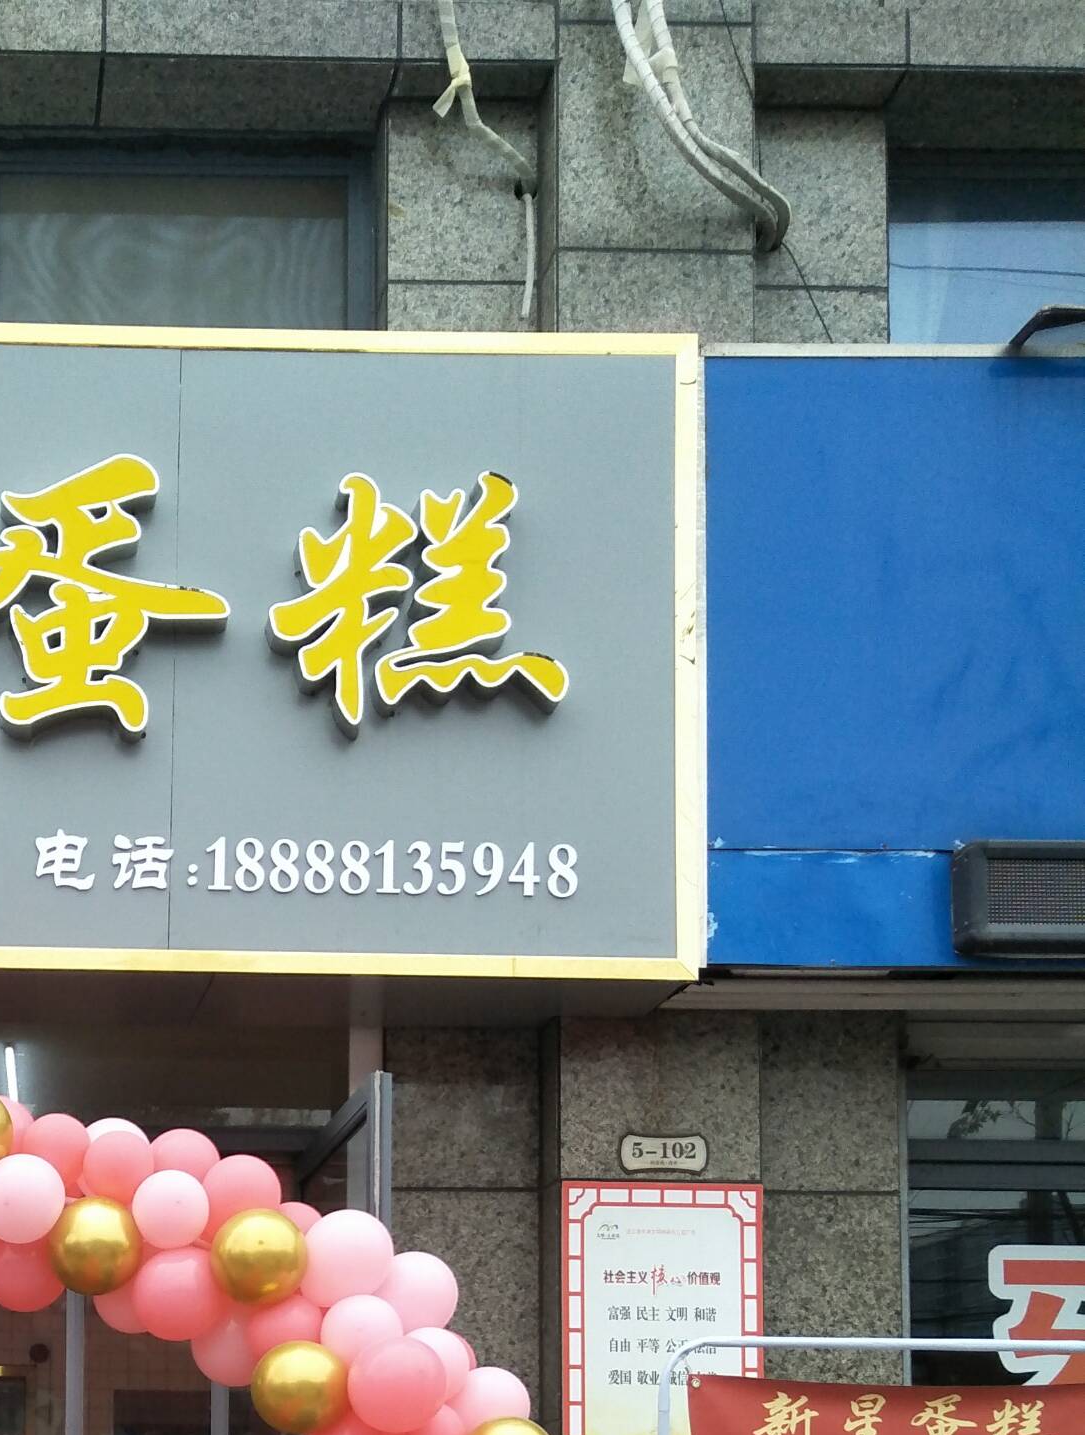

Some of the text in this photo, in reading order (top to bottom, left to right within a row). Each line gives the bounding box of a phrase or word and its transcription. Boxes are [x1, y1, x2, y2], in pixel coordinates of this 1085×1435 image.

[631, 1142, 697, 1159] 5-102
[607, 1305, 717, 1322] 富强 民主 文明 和谐
[609, 1337, 631, 1353] 自由
[636, 1338, 660, 1354] 平等
[607, 1369, 632, 1385] 爱国
[636, 1369, 661, 1386] 敬业
